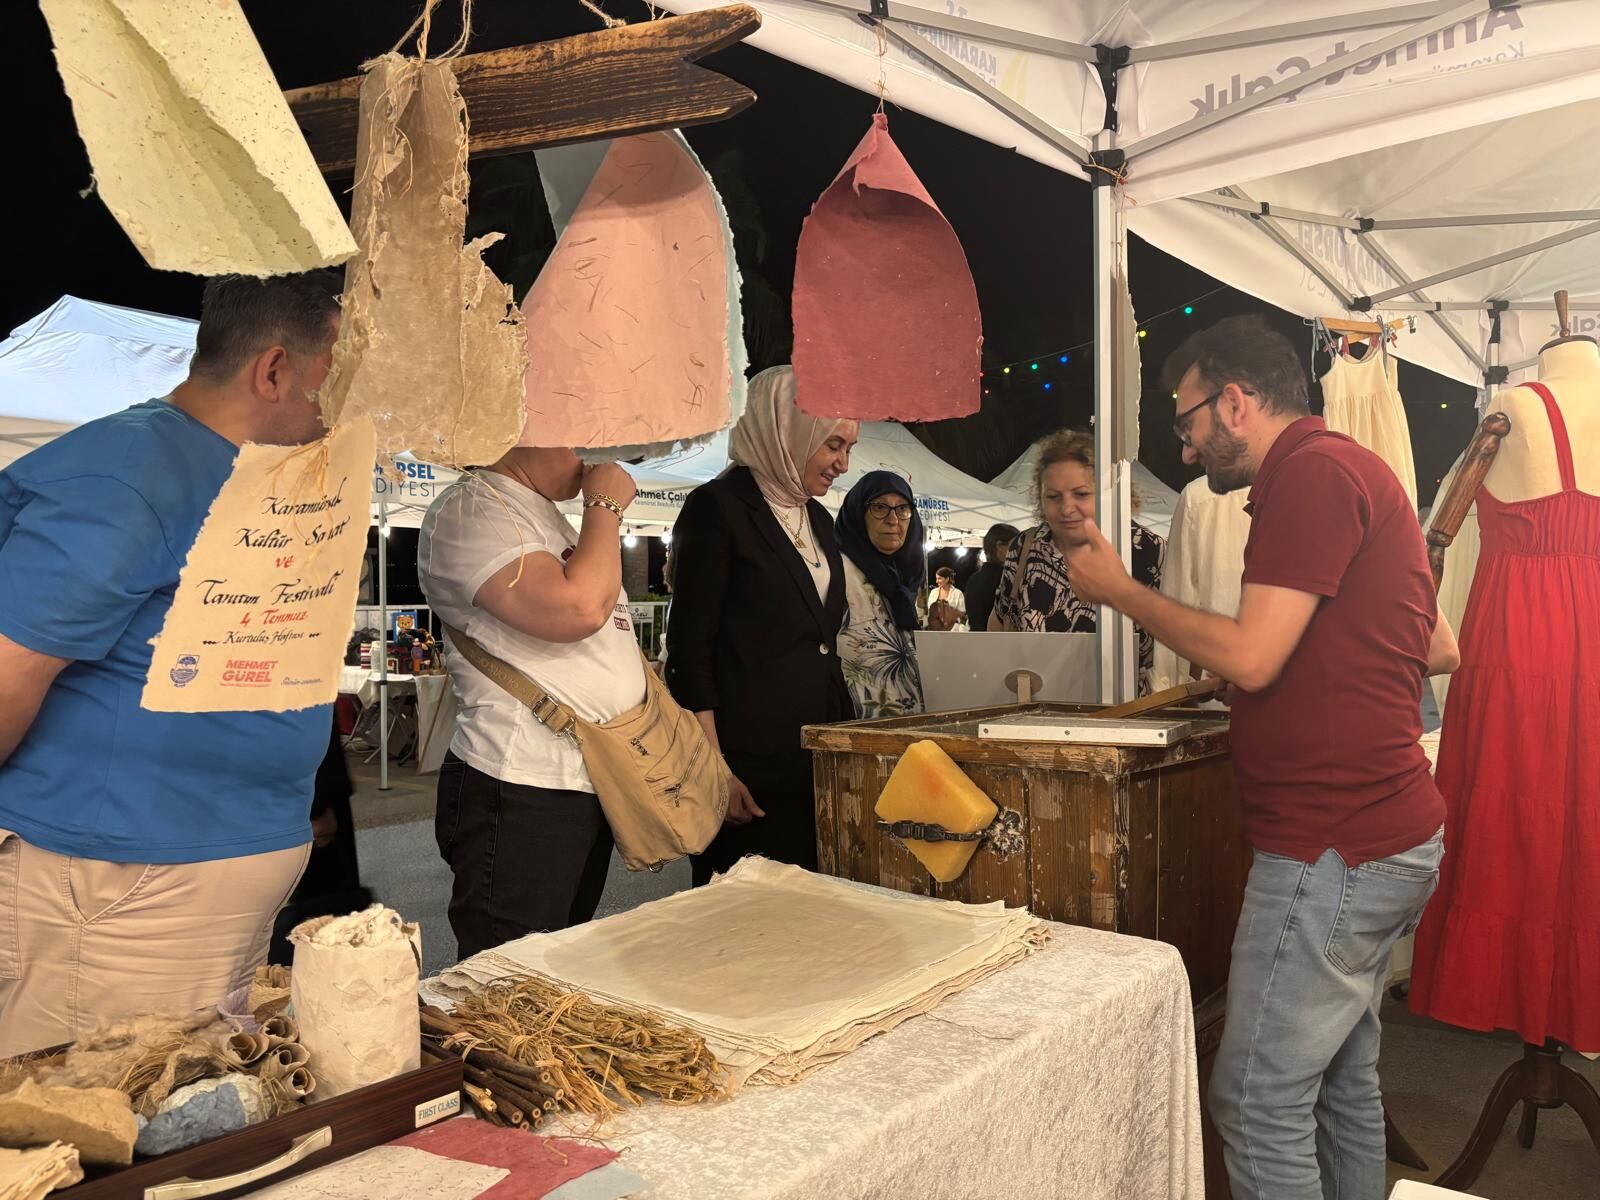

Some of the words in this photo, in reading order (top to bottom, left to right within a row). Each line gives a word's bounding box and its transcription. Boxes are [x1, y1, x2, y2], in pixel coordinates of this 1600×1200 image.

[667, 491, 688, 504] Çalı
[913, 497, 950, 511] RAMÜRSEL
[233, 529, 293, 549] Kültür
[274, 555, 294, 569] ve
[270, 568, 344, 605] Festivali
[239, 611, 251, 627] 4
[261, 608, 308, 625] Temmuz
[225, 659, 279, 670] MEHMET
[222, 670, 273, 683] GÜREL
[418, 1104, 437, 1120] FIRST
[437, 1097, 458, 1113] CLASS
